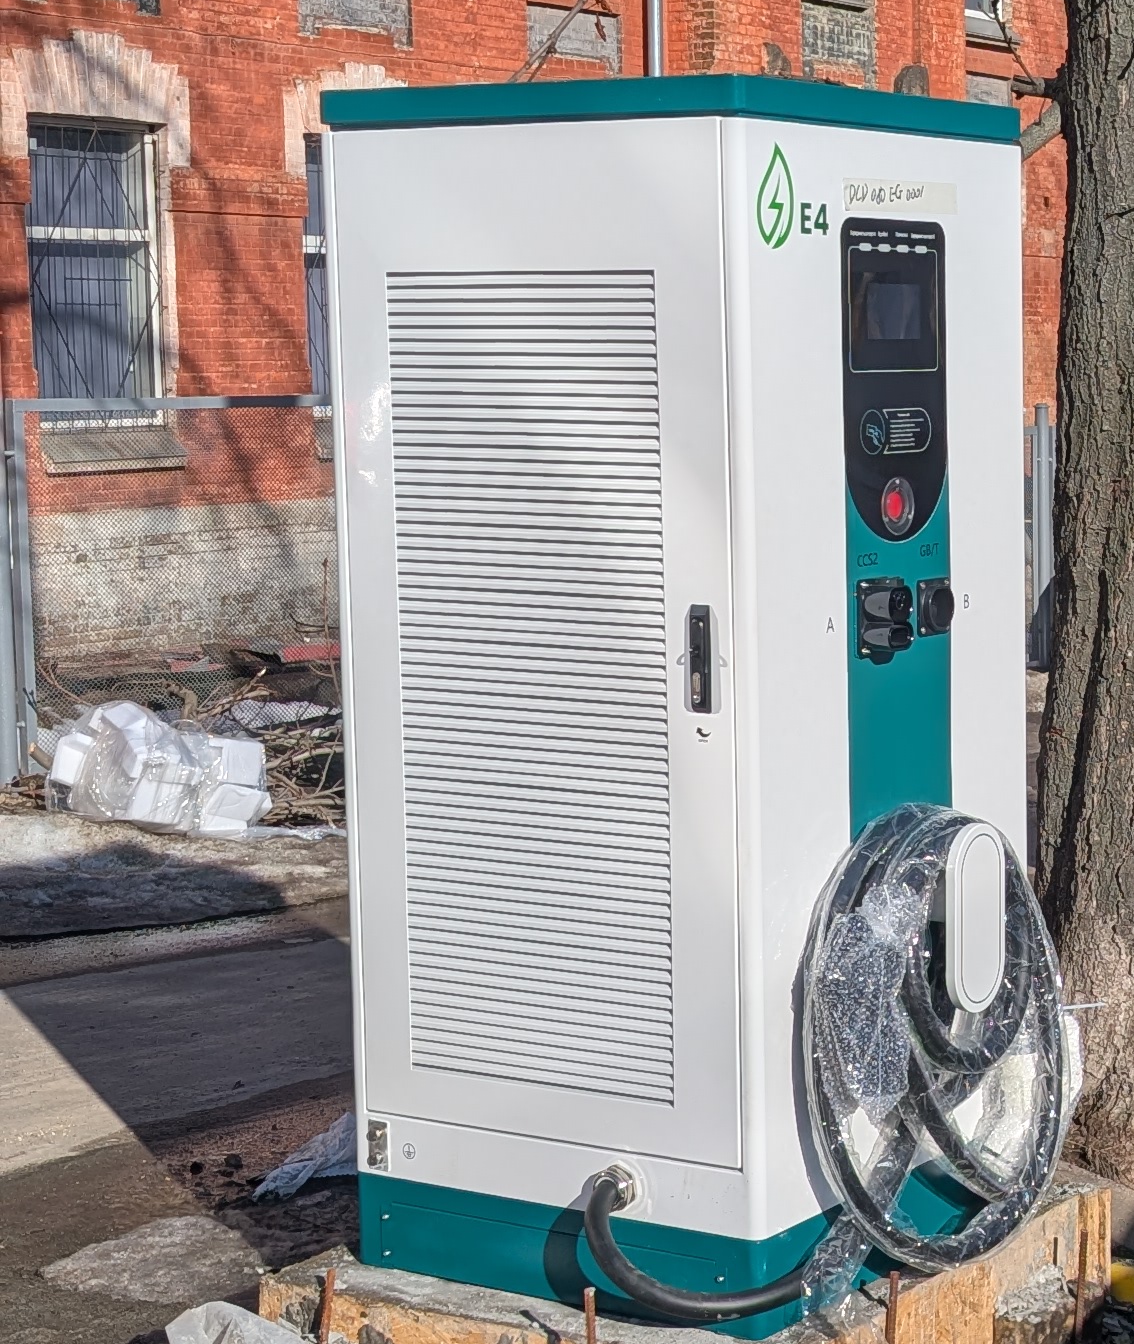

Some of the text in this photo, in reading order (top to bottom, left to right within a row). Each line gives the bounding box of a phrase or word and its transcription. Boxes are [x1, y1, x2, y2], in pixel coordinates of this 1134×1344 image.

[800, 202, 829, 236] E4
[919, 542, 939, 557] GB/T
[857, 552, 879, 568] CCS2
[963, 593, 970, 610] B
[826, 617, 835, 634] A
